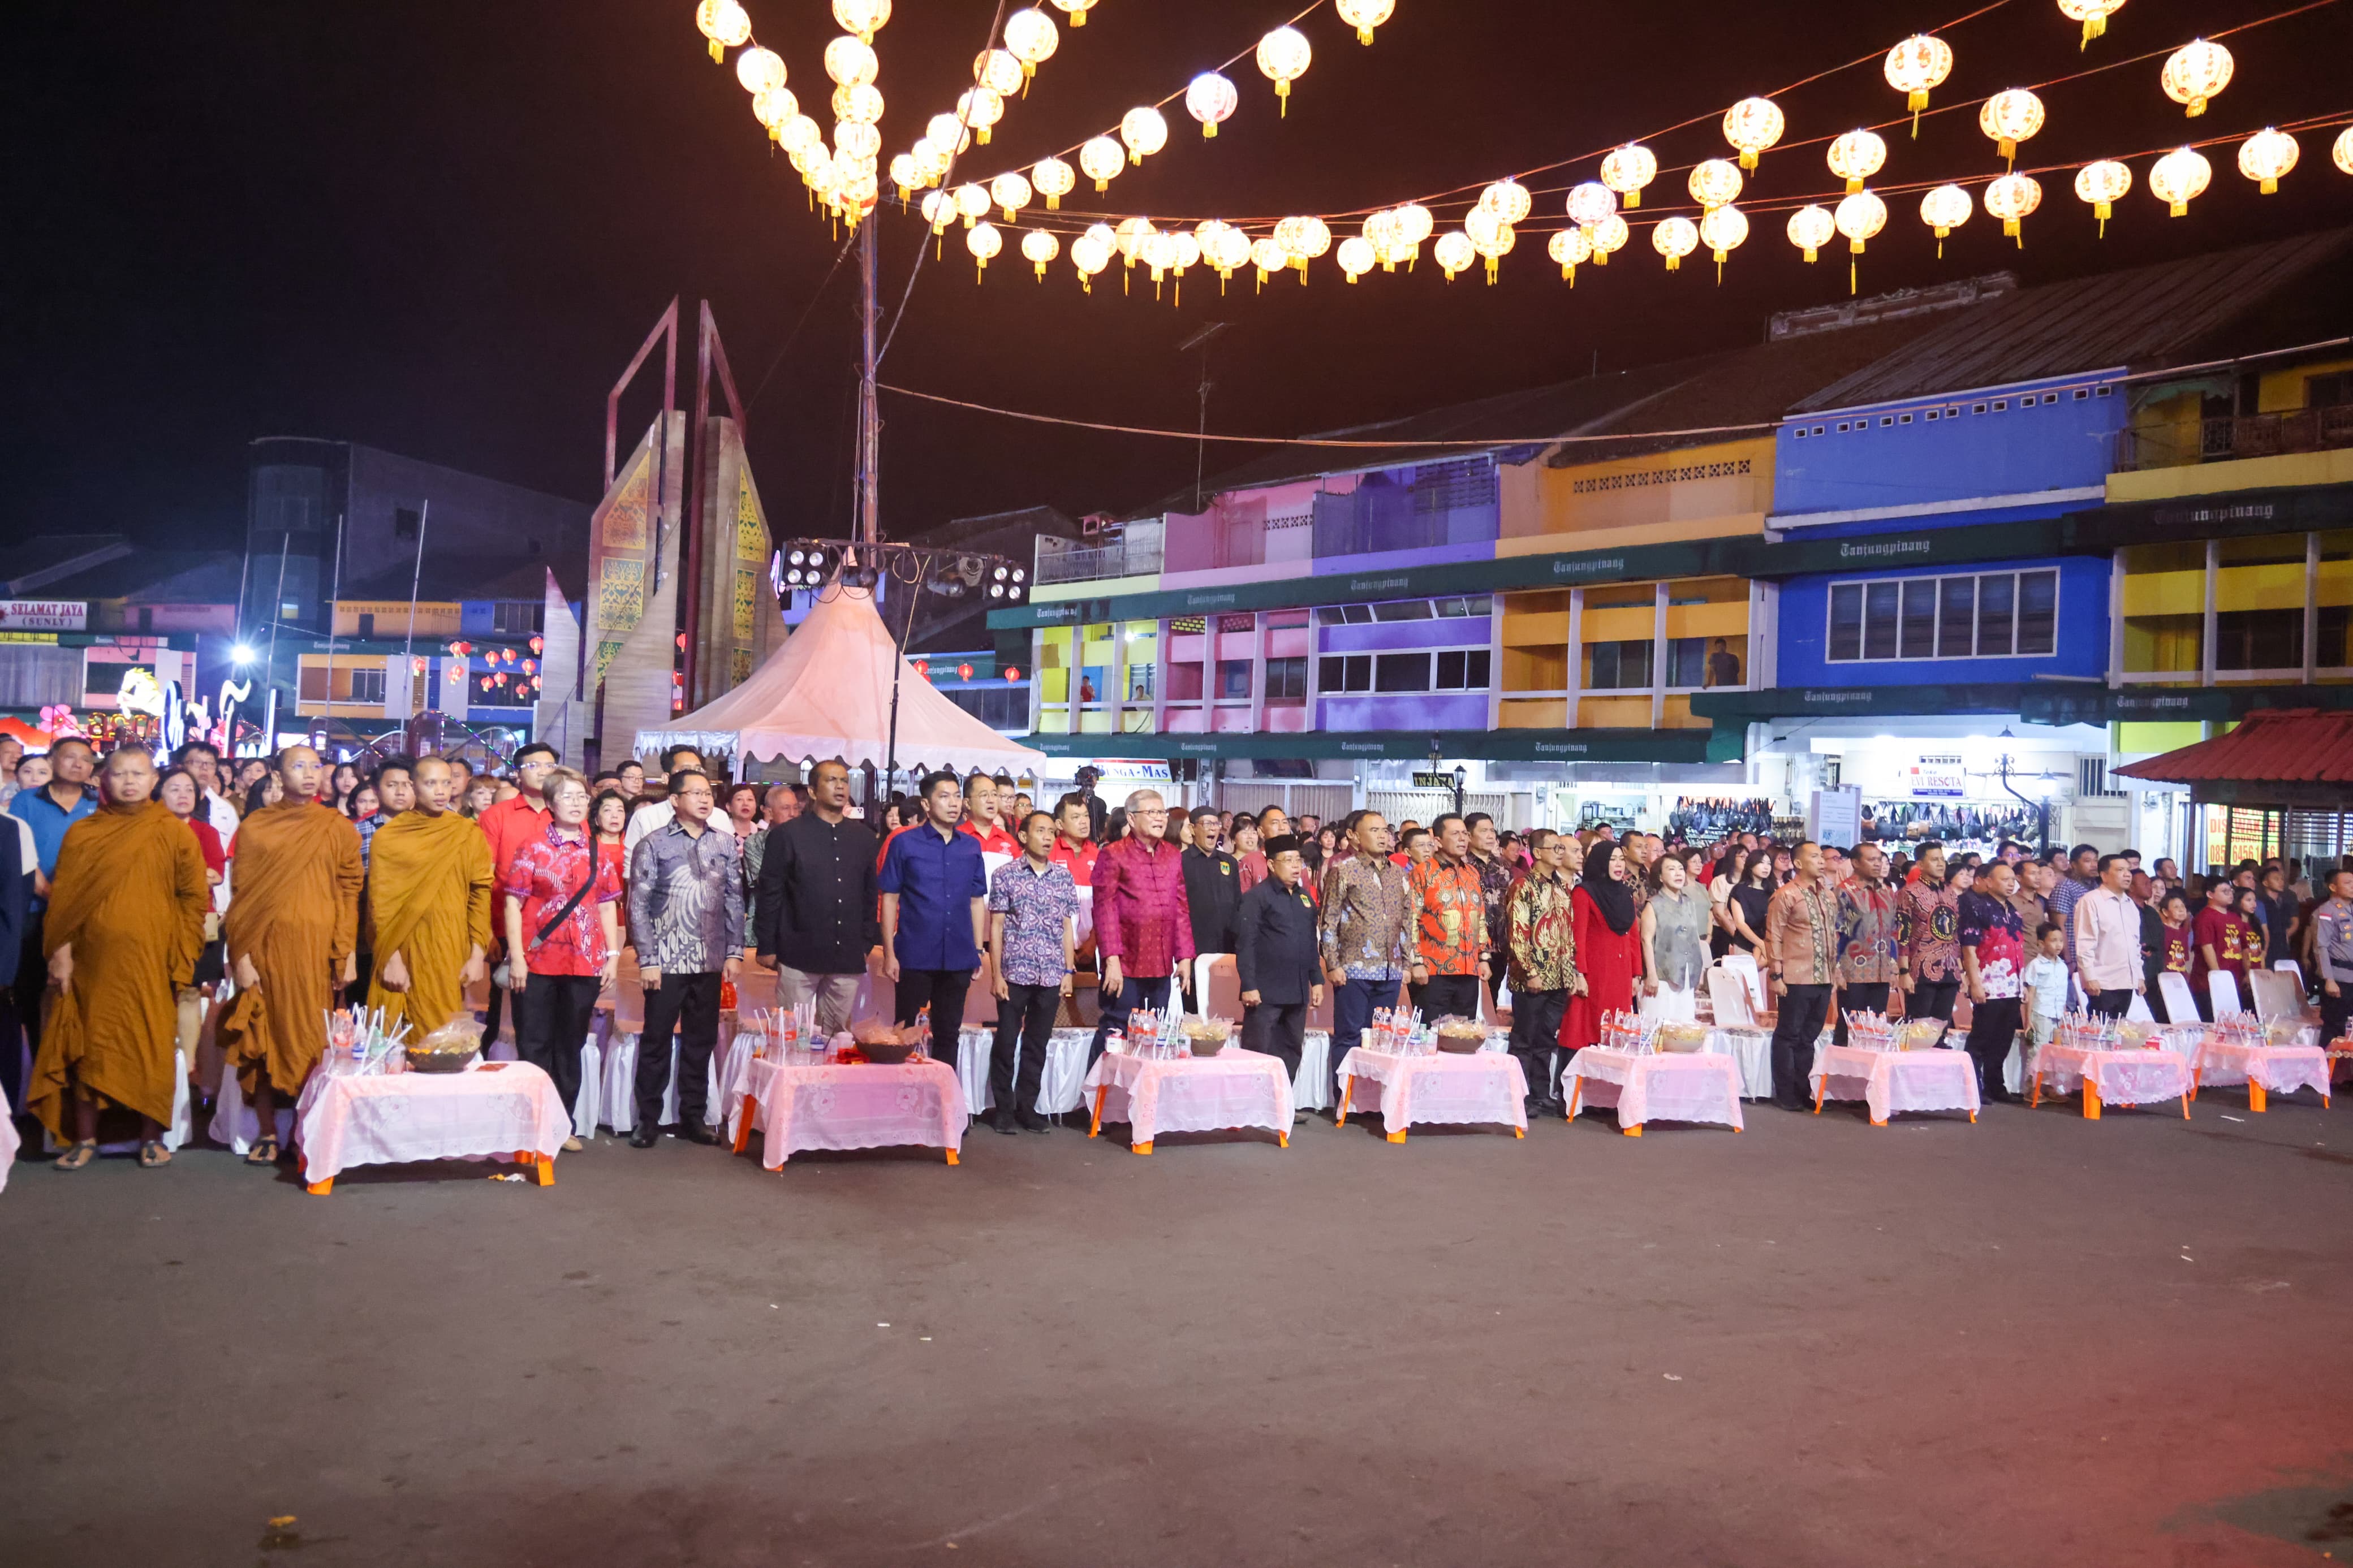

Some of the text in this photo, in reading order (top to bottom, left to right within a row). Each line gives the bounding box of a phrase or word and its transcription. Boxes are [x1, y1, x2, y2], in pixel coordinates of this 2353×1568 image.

[1841, 541, 1930, 557] Tanjungpinang
[1554, 559, 1623, 573] Tanjungpinang
[11, 603, 83, 616] SELAMAT JAYA
[926, 666, 958, 675] anjungpinang
[1804, 691, 1872, 703] Tanjungpinang
[2117, 695, 2188, 709] Tangpinang
[1342, 742, 1384, 751] Tanjungpinang
[1535, 742, 1587, 753] Tanjungpinang
[2210, 818, 2276, 833] DISWAKN
